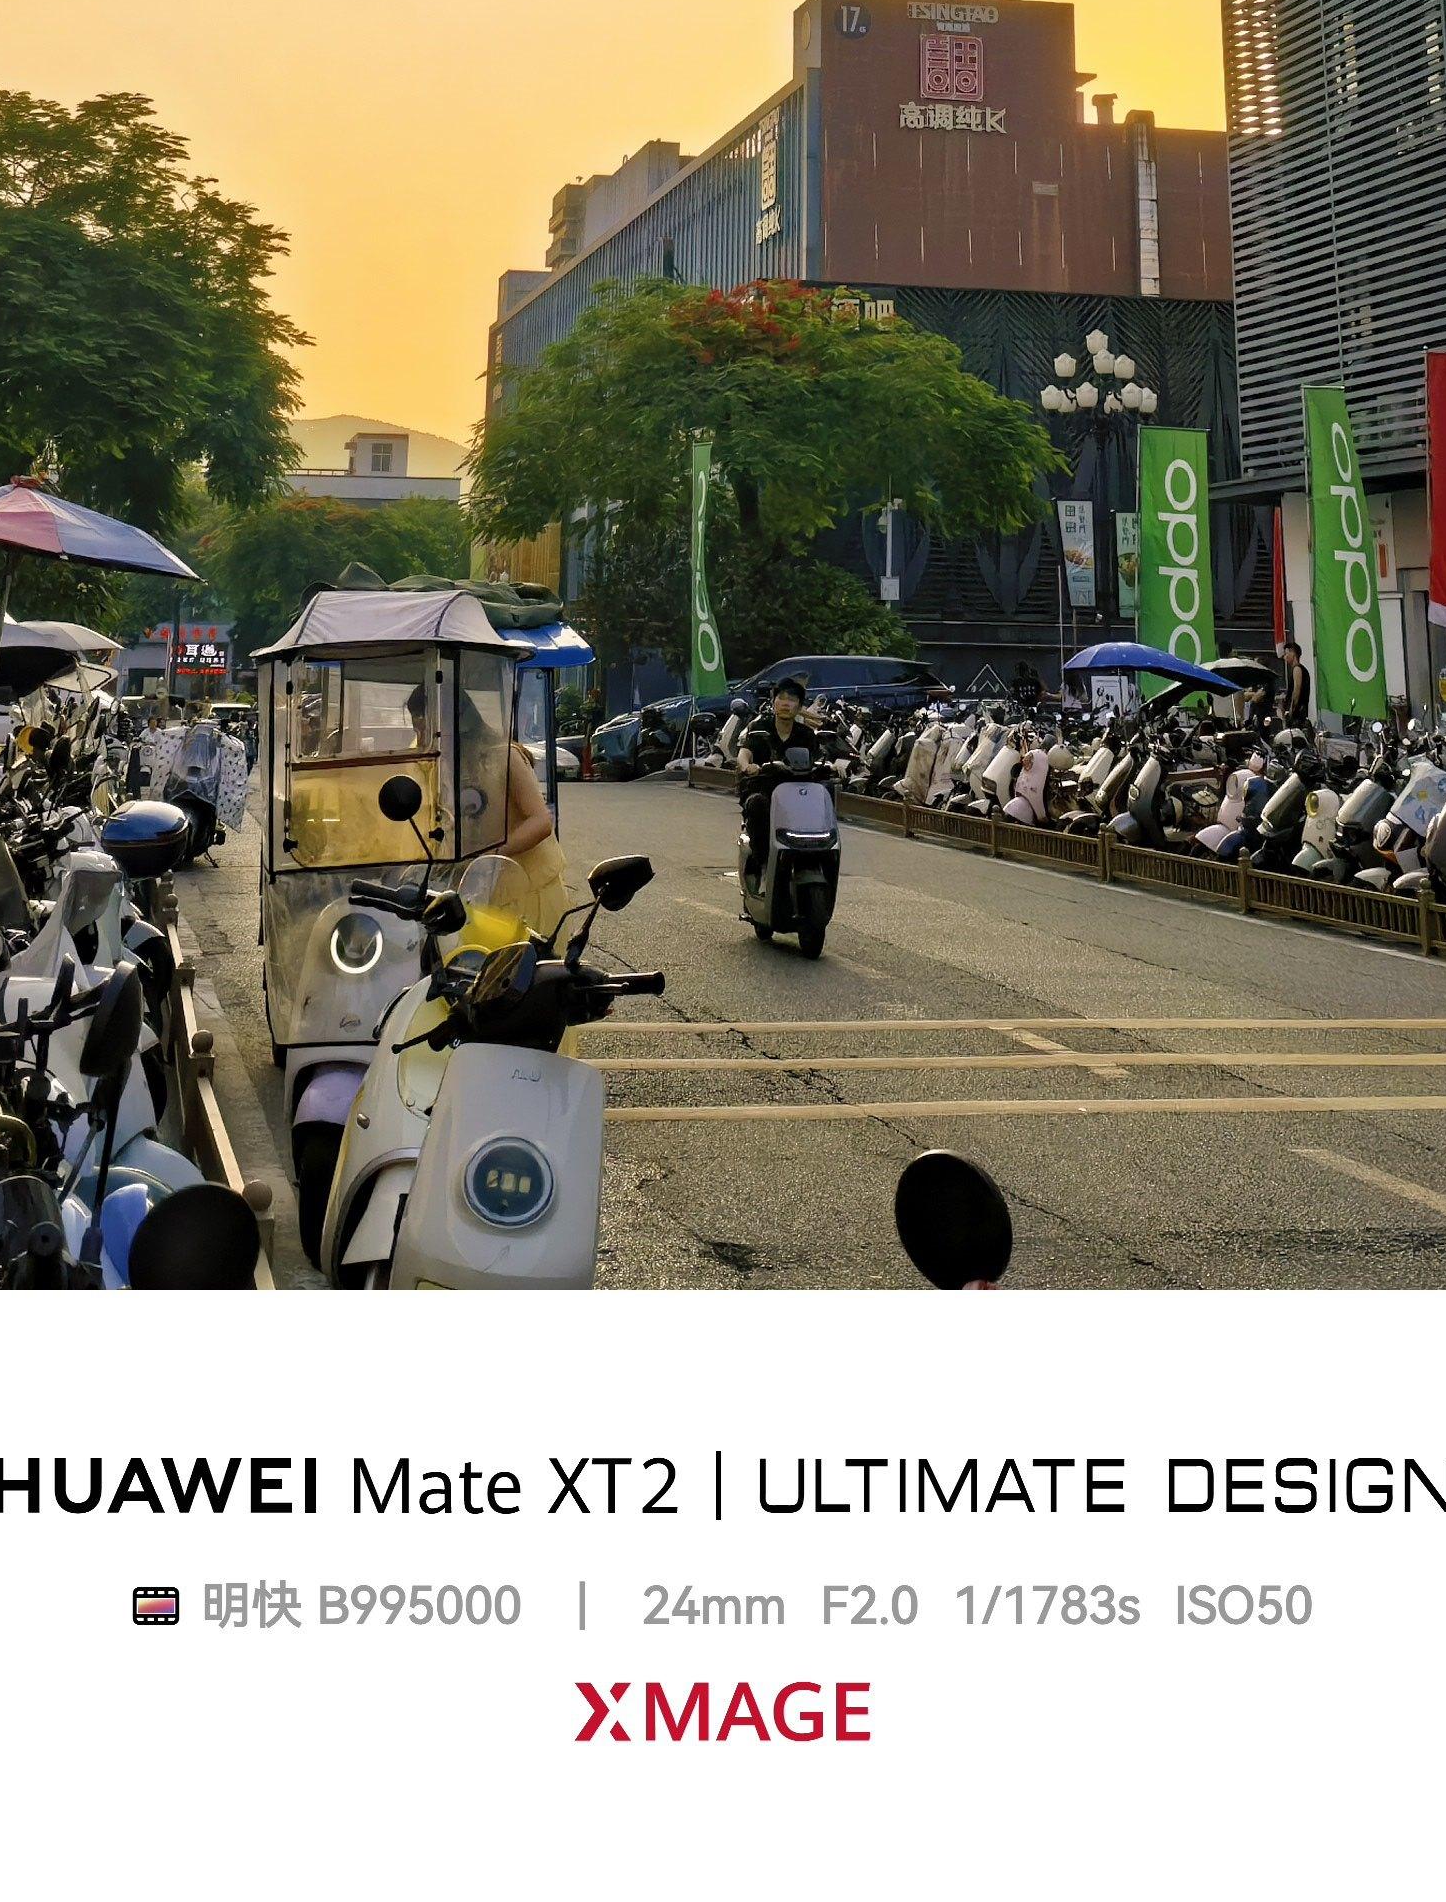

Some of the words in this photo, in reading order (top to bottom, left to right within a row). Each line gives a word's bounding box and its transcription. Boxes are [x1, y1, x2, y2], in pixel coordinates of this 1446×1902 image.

[840, 5, 861, 32] 17
[907, 1, 999, 24] TSINGTAO
[899, 101, 1007, 134] 高调纯K
[1157, 459, 1202, 665] oppo
[1330, 422, 1378, 682] oppo
